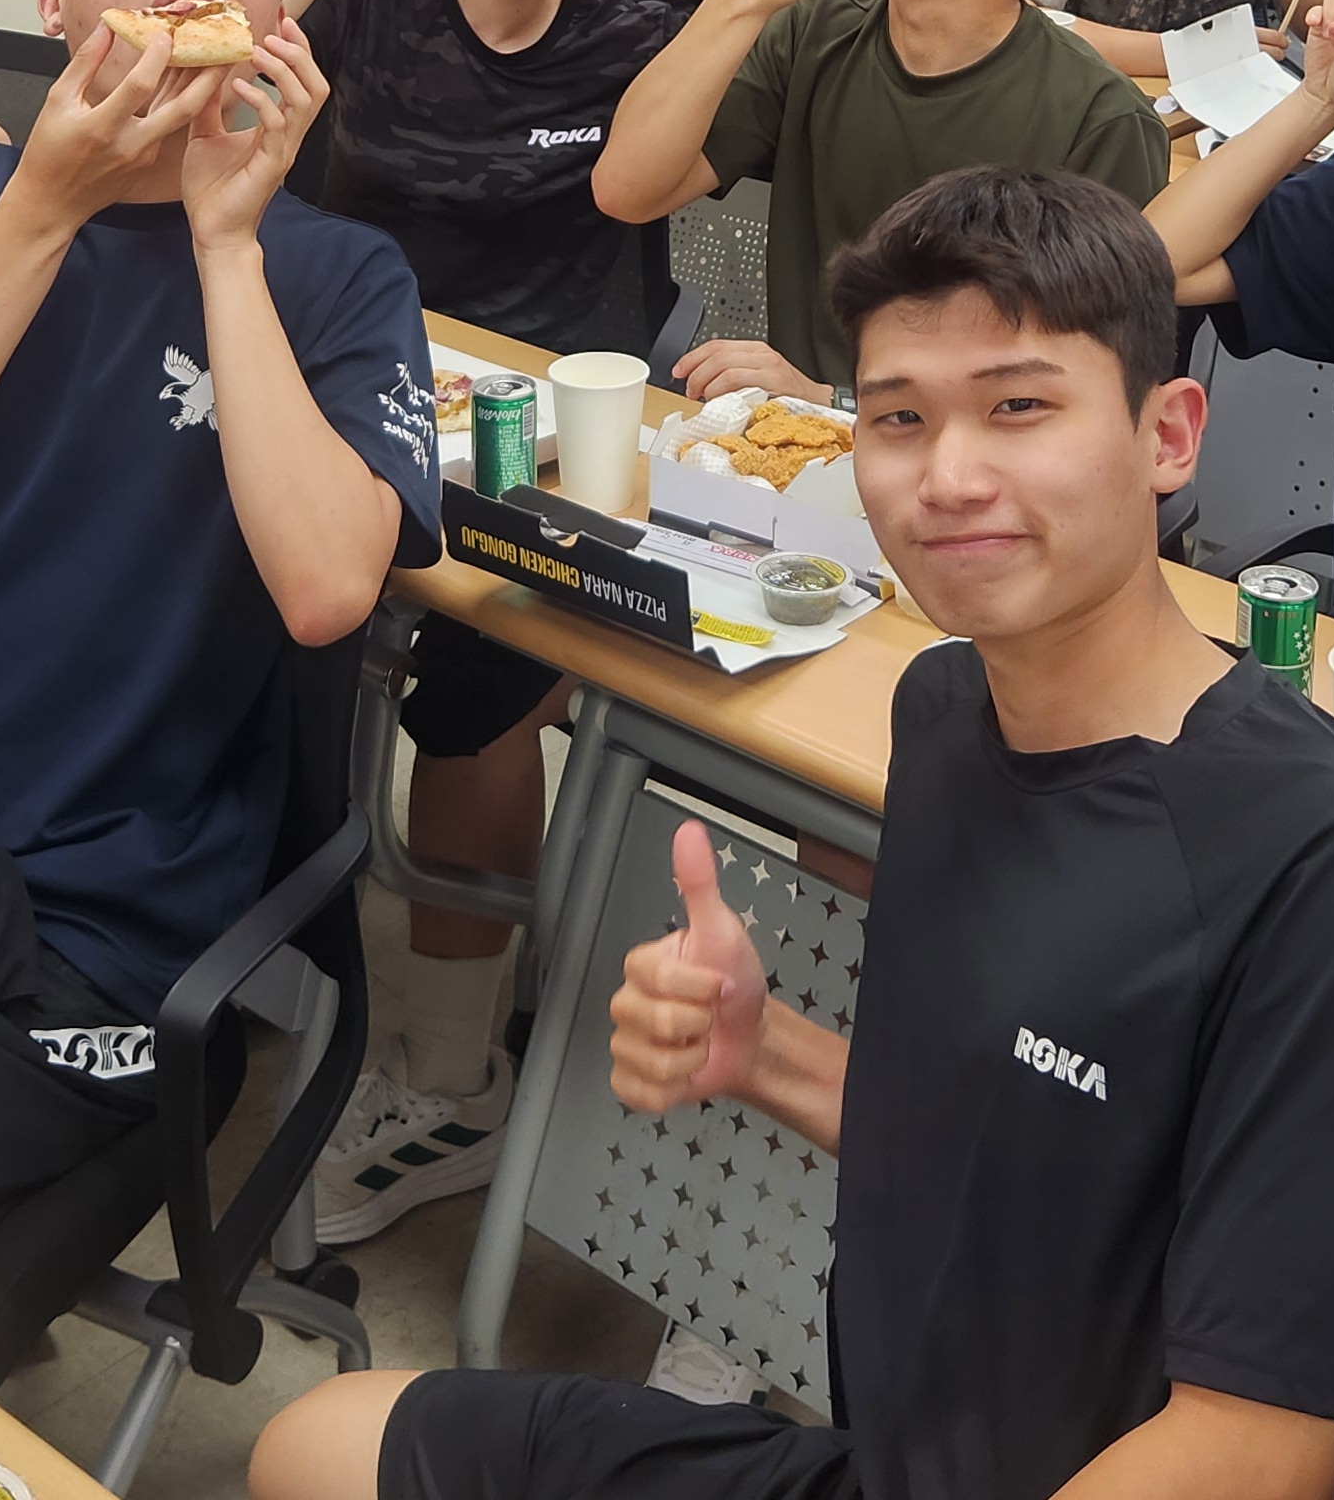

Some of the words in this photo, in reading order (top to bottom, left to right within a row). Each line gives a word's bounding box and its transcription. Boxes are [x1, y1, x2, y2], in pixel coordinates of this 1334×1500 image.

[527, 126, 601, 148] ROKA
[461, 525, 518, 564] GONGJU
[519, 547, 581, 588] CHICKEN
[581, 570, 624, 606] NARA
[625, 585, 667, 623] PIZZA
[1014, 1026, 1107, 1101] ROKA
